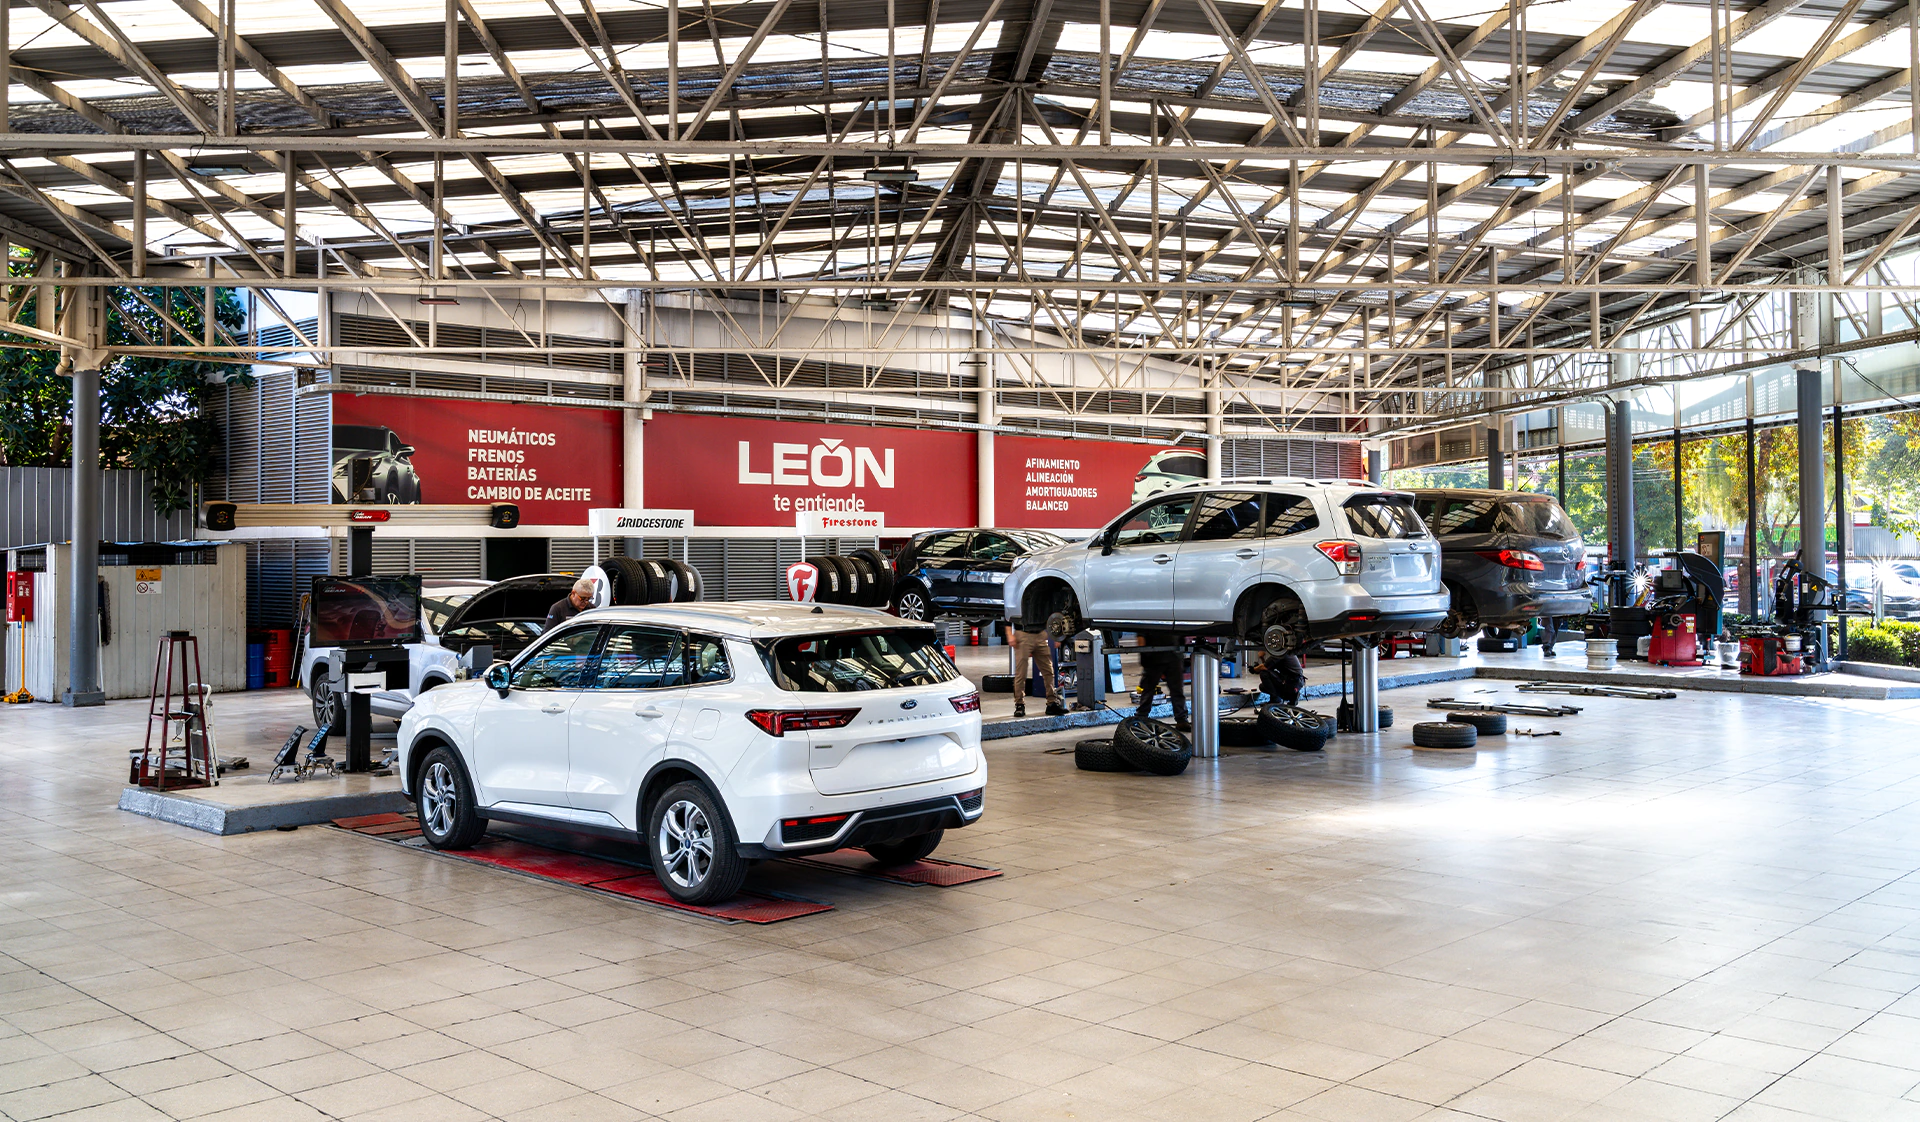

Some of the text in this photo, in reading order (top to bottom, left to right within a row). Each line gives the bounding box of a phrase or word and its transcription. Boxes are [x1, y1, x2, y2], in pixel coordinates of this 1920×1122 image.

[468, 427, 556, 446] NEUMÁTICOS
[468, 448, 525, 463] FRENOS
[738, 438, 895, 489] LEÓN
[1025, 457, 1080, 470] AFINAMIENTO
[467, 464, 537, 481] BATERÍAS
[1025, 470, 1074, 483] ALINEACIÓN
[467, 485, 591, 501] CAMBIO DE ACEITE
[1025, 486, 1098, 498] AMORTIGUADORES
[773, 493, 865, 513] te entiende
[1025, 500, 1069, 511] BALANCEO
[616, 516, 685, 528] BRIDGESTONE
[822, 516, 878, 529] Firestone
